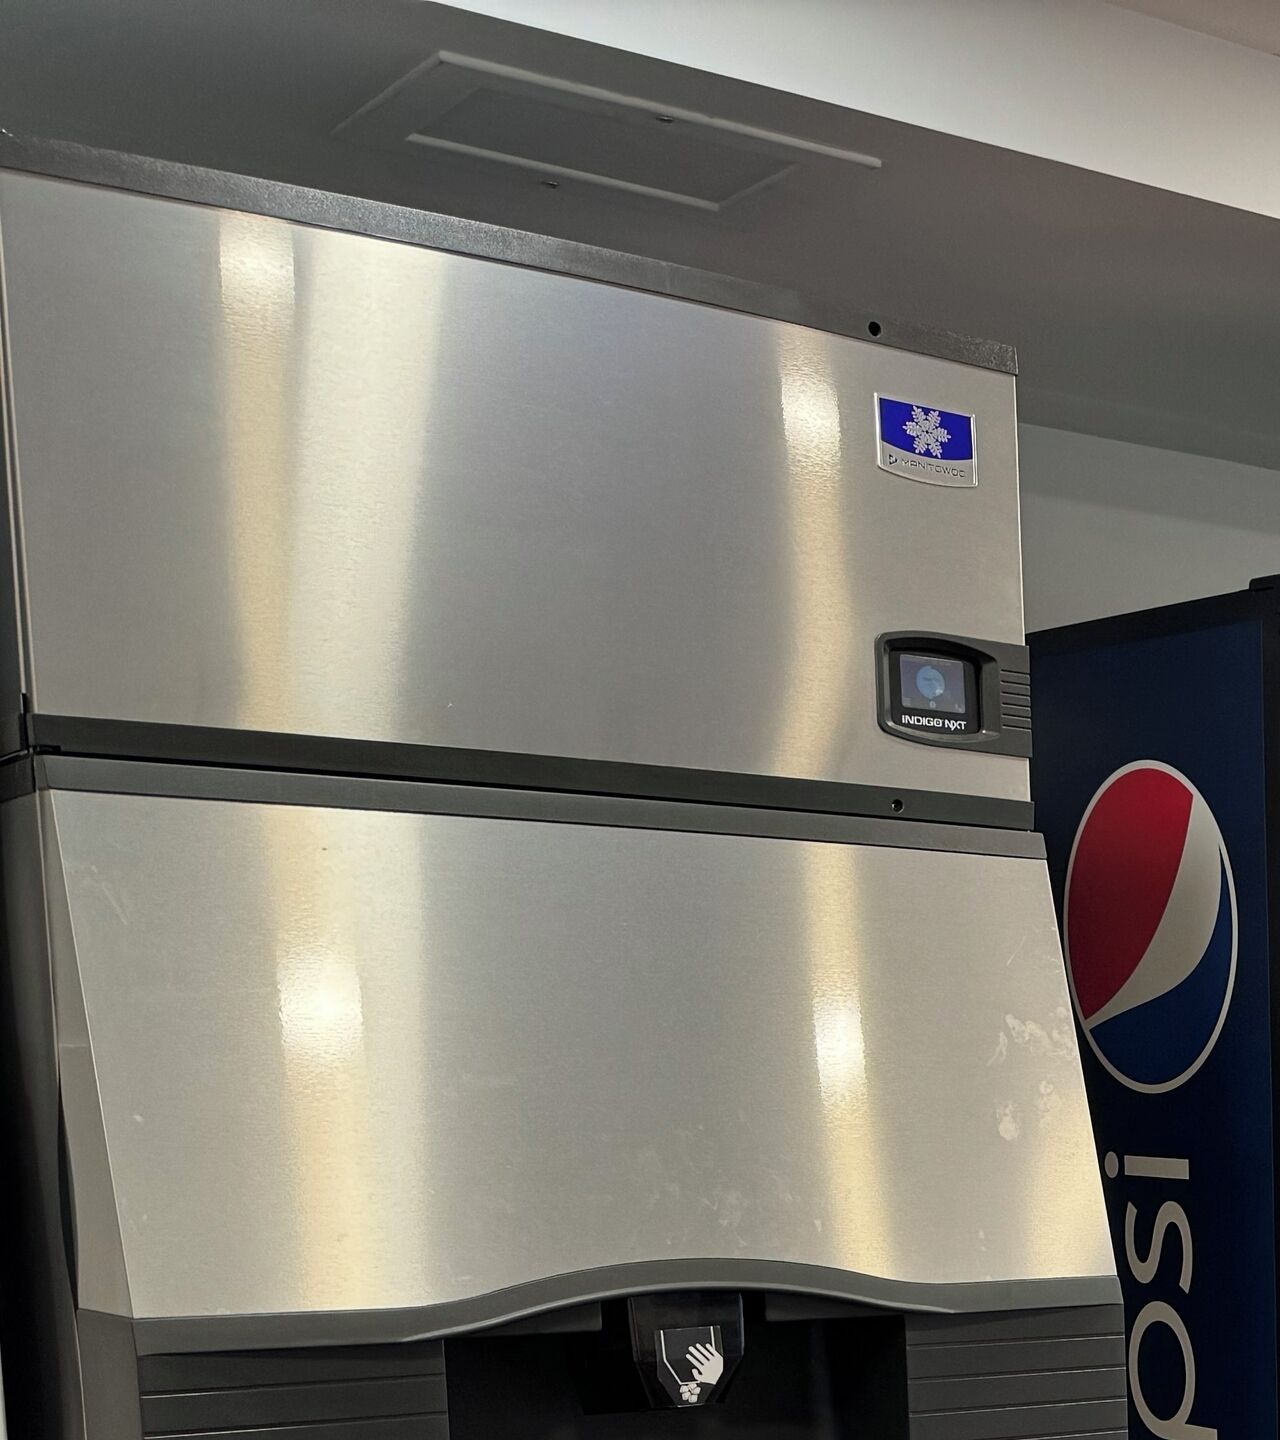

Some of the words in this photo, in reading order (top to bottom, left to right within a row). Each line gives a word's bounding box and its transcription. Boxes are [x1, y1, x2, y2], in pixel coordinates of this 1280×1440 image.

[902, 458, 966, 478] MANITOWOC
[902, 714, 943, 728] INDIGO
[944, 719, 967, 732] NXT
